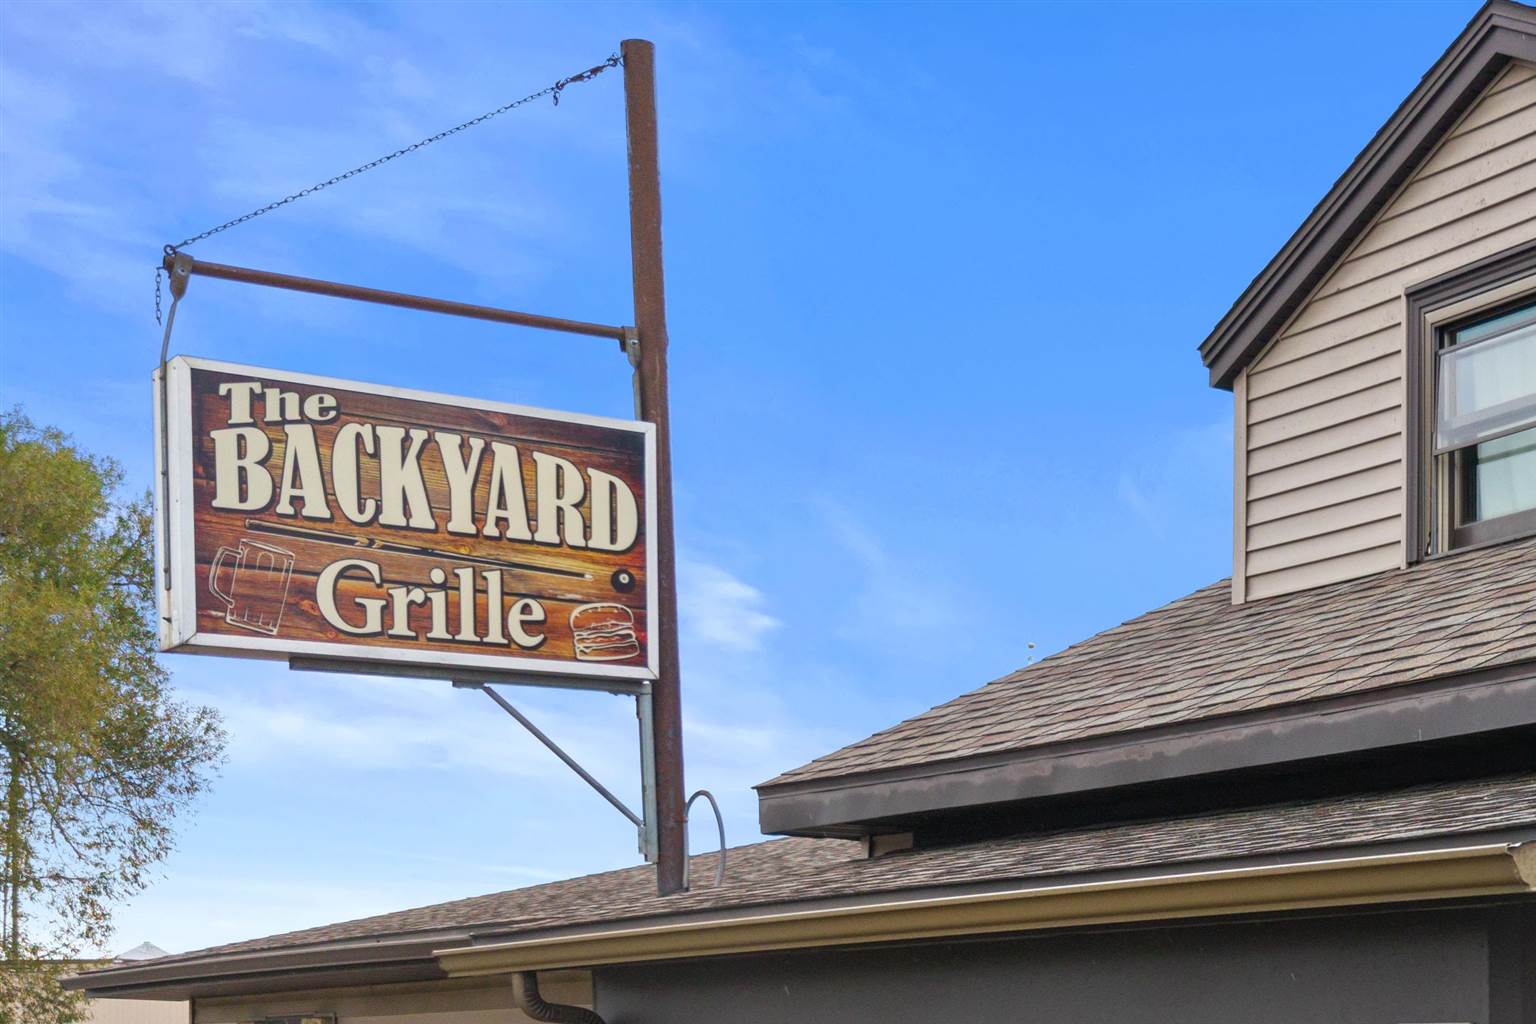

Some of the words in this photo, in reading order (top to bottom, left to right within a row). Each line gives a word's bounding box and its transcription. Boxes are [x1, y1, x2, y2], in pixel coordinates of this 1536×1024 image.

[219, 382, 338, 424] The
[210, 423, 639, 553] BACKYARD
[316, 559, 547, 649] Grille
